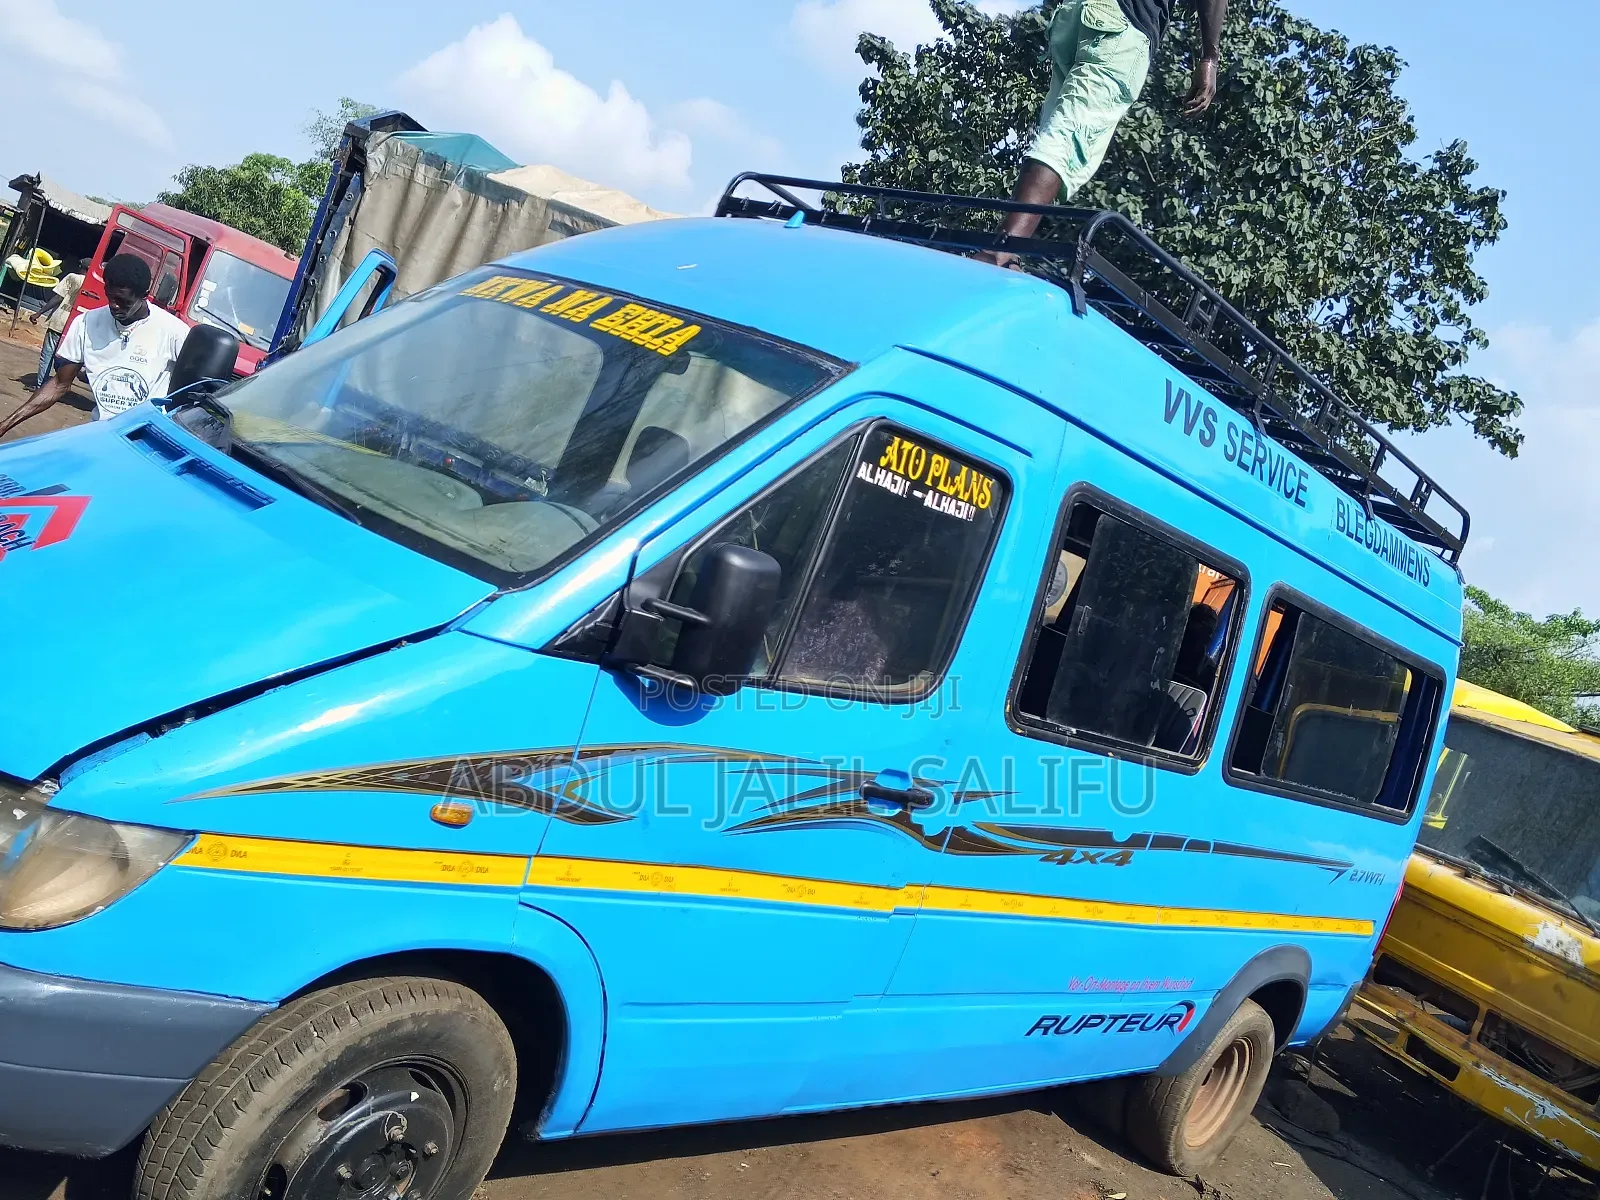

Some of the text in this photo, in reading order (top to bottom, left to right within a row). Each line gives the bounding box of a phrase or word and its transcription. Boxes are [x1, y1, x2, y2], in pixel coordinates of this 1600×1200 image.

[539, 289, 614, 323] NA
[589, 303, 702, 357] EHIA
[879, 436, 993, 509] ATO PLANS
[1164, 378, 1431, 588] VVS SERVICE BLEGDAMMENS
[1024, 1013, 1184, 1037] RUPTEUR
